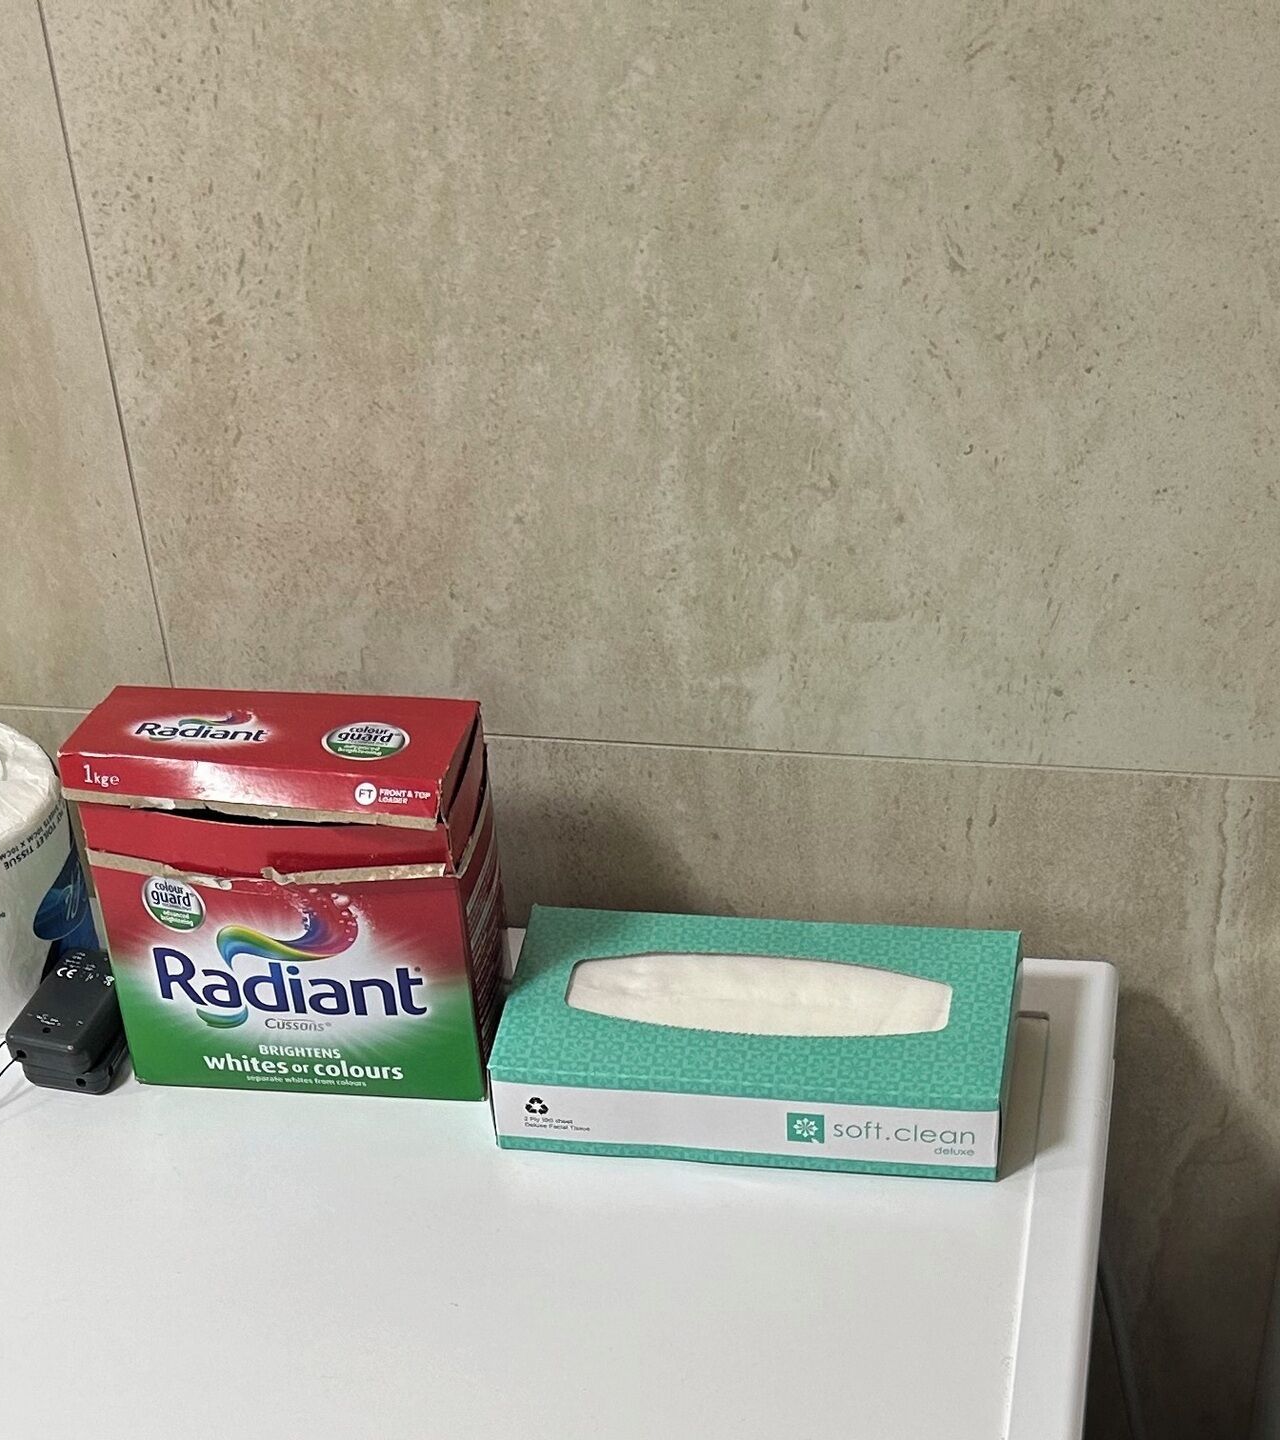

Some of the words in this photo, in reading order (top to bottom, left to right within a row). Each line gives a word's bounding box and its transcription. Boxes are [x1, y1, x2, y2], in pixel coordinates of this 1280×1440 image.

[135, 722, 268, 742] Radiant
[338, 732, 394, 743] guard
[349, 726, 388, 735] colour
[359, 788, 374, 799] FT
[378, 796, 409, 805] LOADER
[379, 788, 406, 798] FRONT
[414, 791, 431, 800] TOP
[3, 846, 34, 871] TISSUE
[155, 880, 184, 895] colour
[151, 890, 191, 907] guard
[152, 947, 428, 1016] Radiant
[259, 1044, 341, 1059] BRIGHTENS
[203, 1053, 289, 1075] whites
[292, 1064, 310, 1074] or
[314, 1060, 404, 1081] colours
[246, 1075, 283, 1084] separate
[284, 1076, 313, 1085] whites
[314, 1078, 335, 1086] from
[336, 1079, 367, 1087] colours
[833, 1121, 975, 1145] soft.clean
[934, 1147, 975, 1156] deluxe
